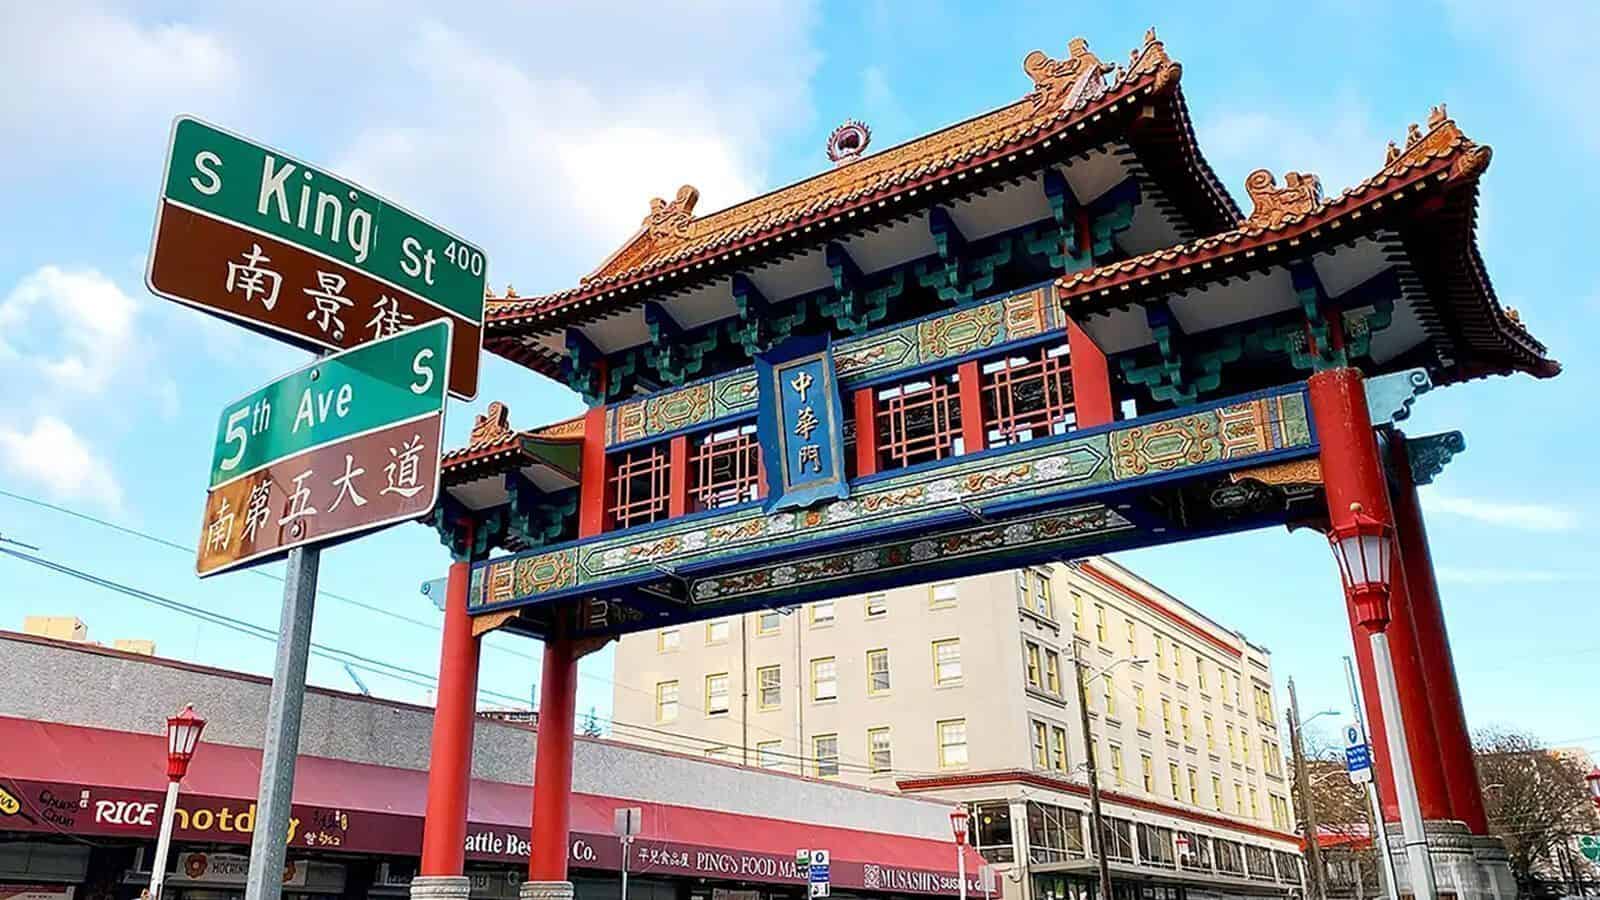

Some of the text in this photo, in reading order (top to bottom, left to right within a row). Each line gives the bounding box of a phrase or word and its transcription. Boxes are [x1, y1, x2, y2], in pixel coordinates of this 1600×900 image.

[190, 151, 483, 285] S King St 400
[219, 349, 434, 472] 5th Ave S
[791, 371, 822, 474] 中華門
[205, 435, 426, 557] 南第五大道
[95, 800, 159, 826] RICE
[465, 831, 597, 861] attle Bes Co.
[741, 856, 777, 876] FOOD
[779, 860, 809, 879] MA
[940, 878, 965, 890] SUS
